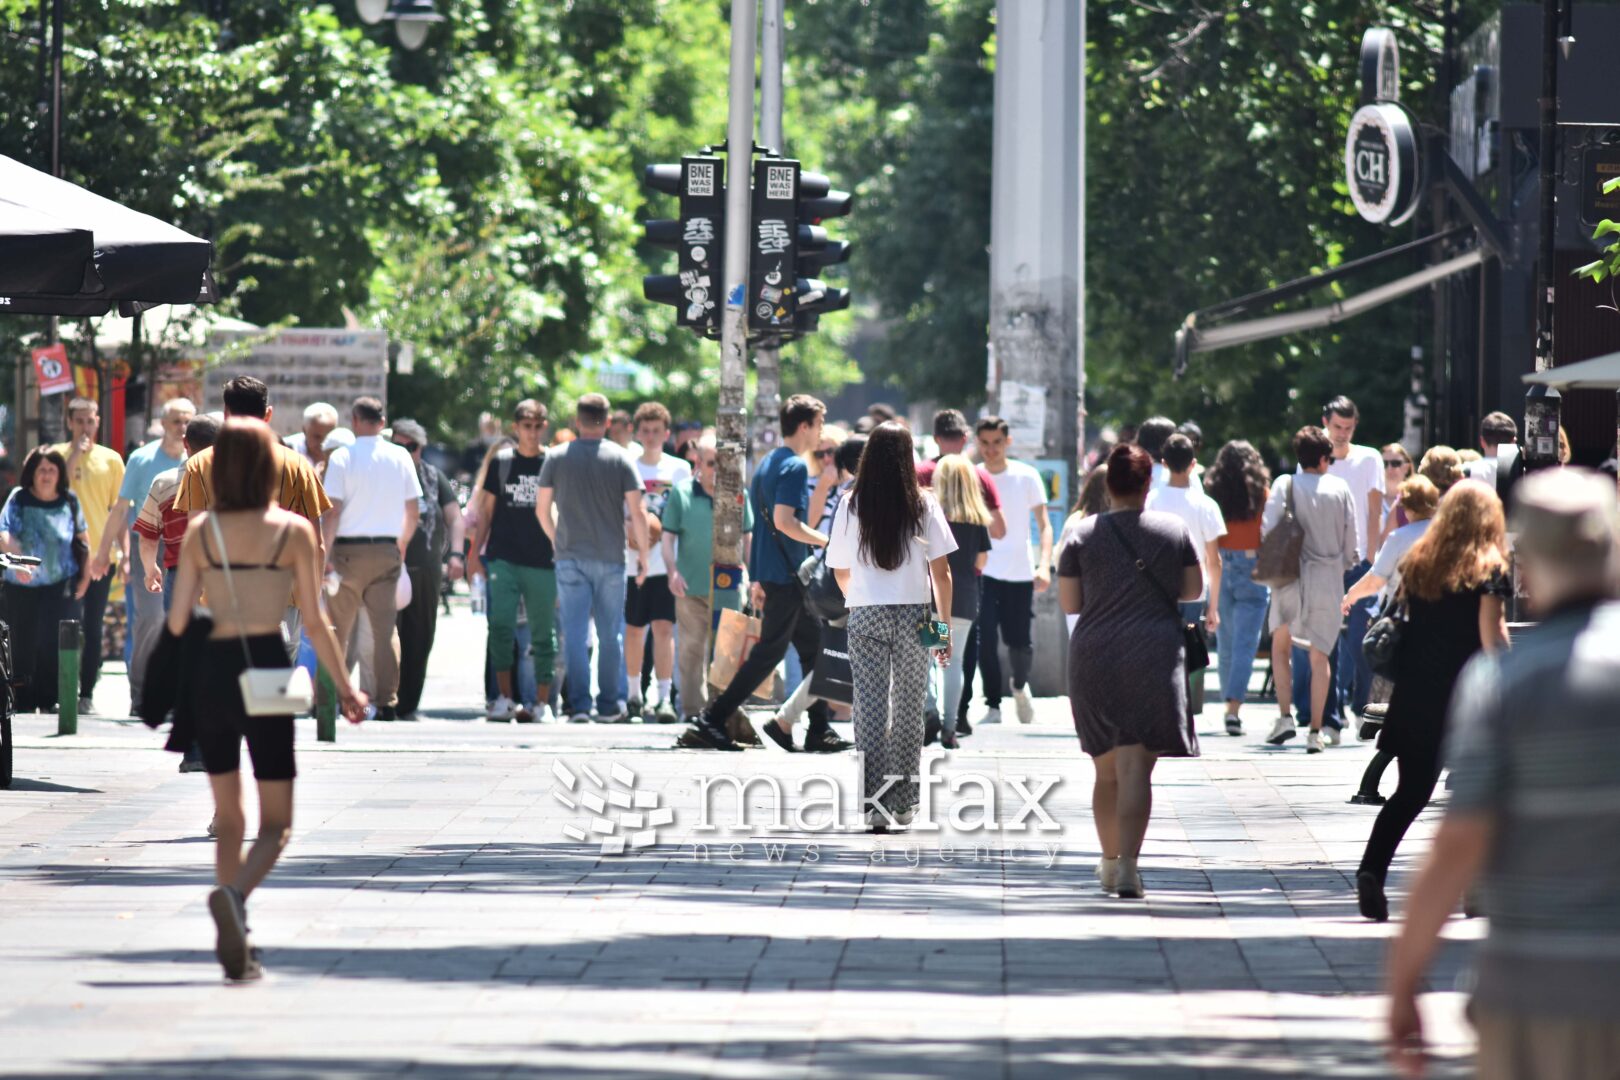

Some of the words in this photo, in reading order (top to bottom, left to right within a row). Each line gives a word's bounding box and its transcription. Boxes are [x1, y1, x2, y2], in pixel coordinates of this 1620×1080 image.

[690, 165, 711, 178] BNE
[1356, 149, 1385, 183] CH
[769, 168, 791, 181] BNE
[690, 186, 711, 194] HERE
